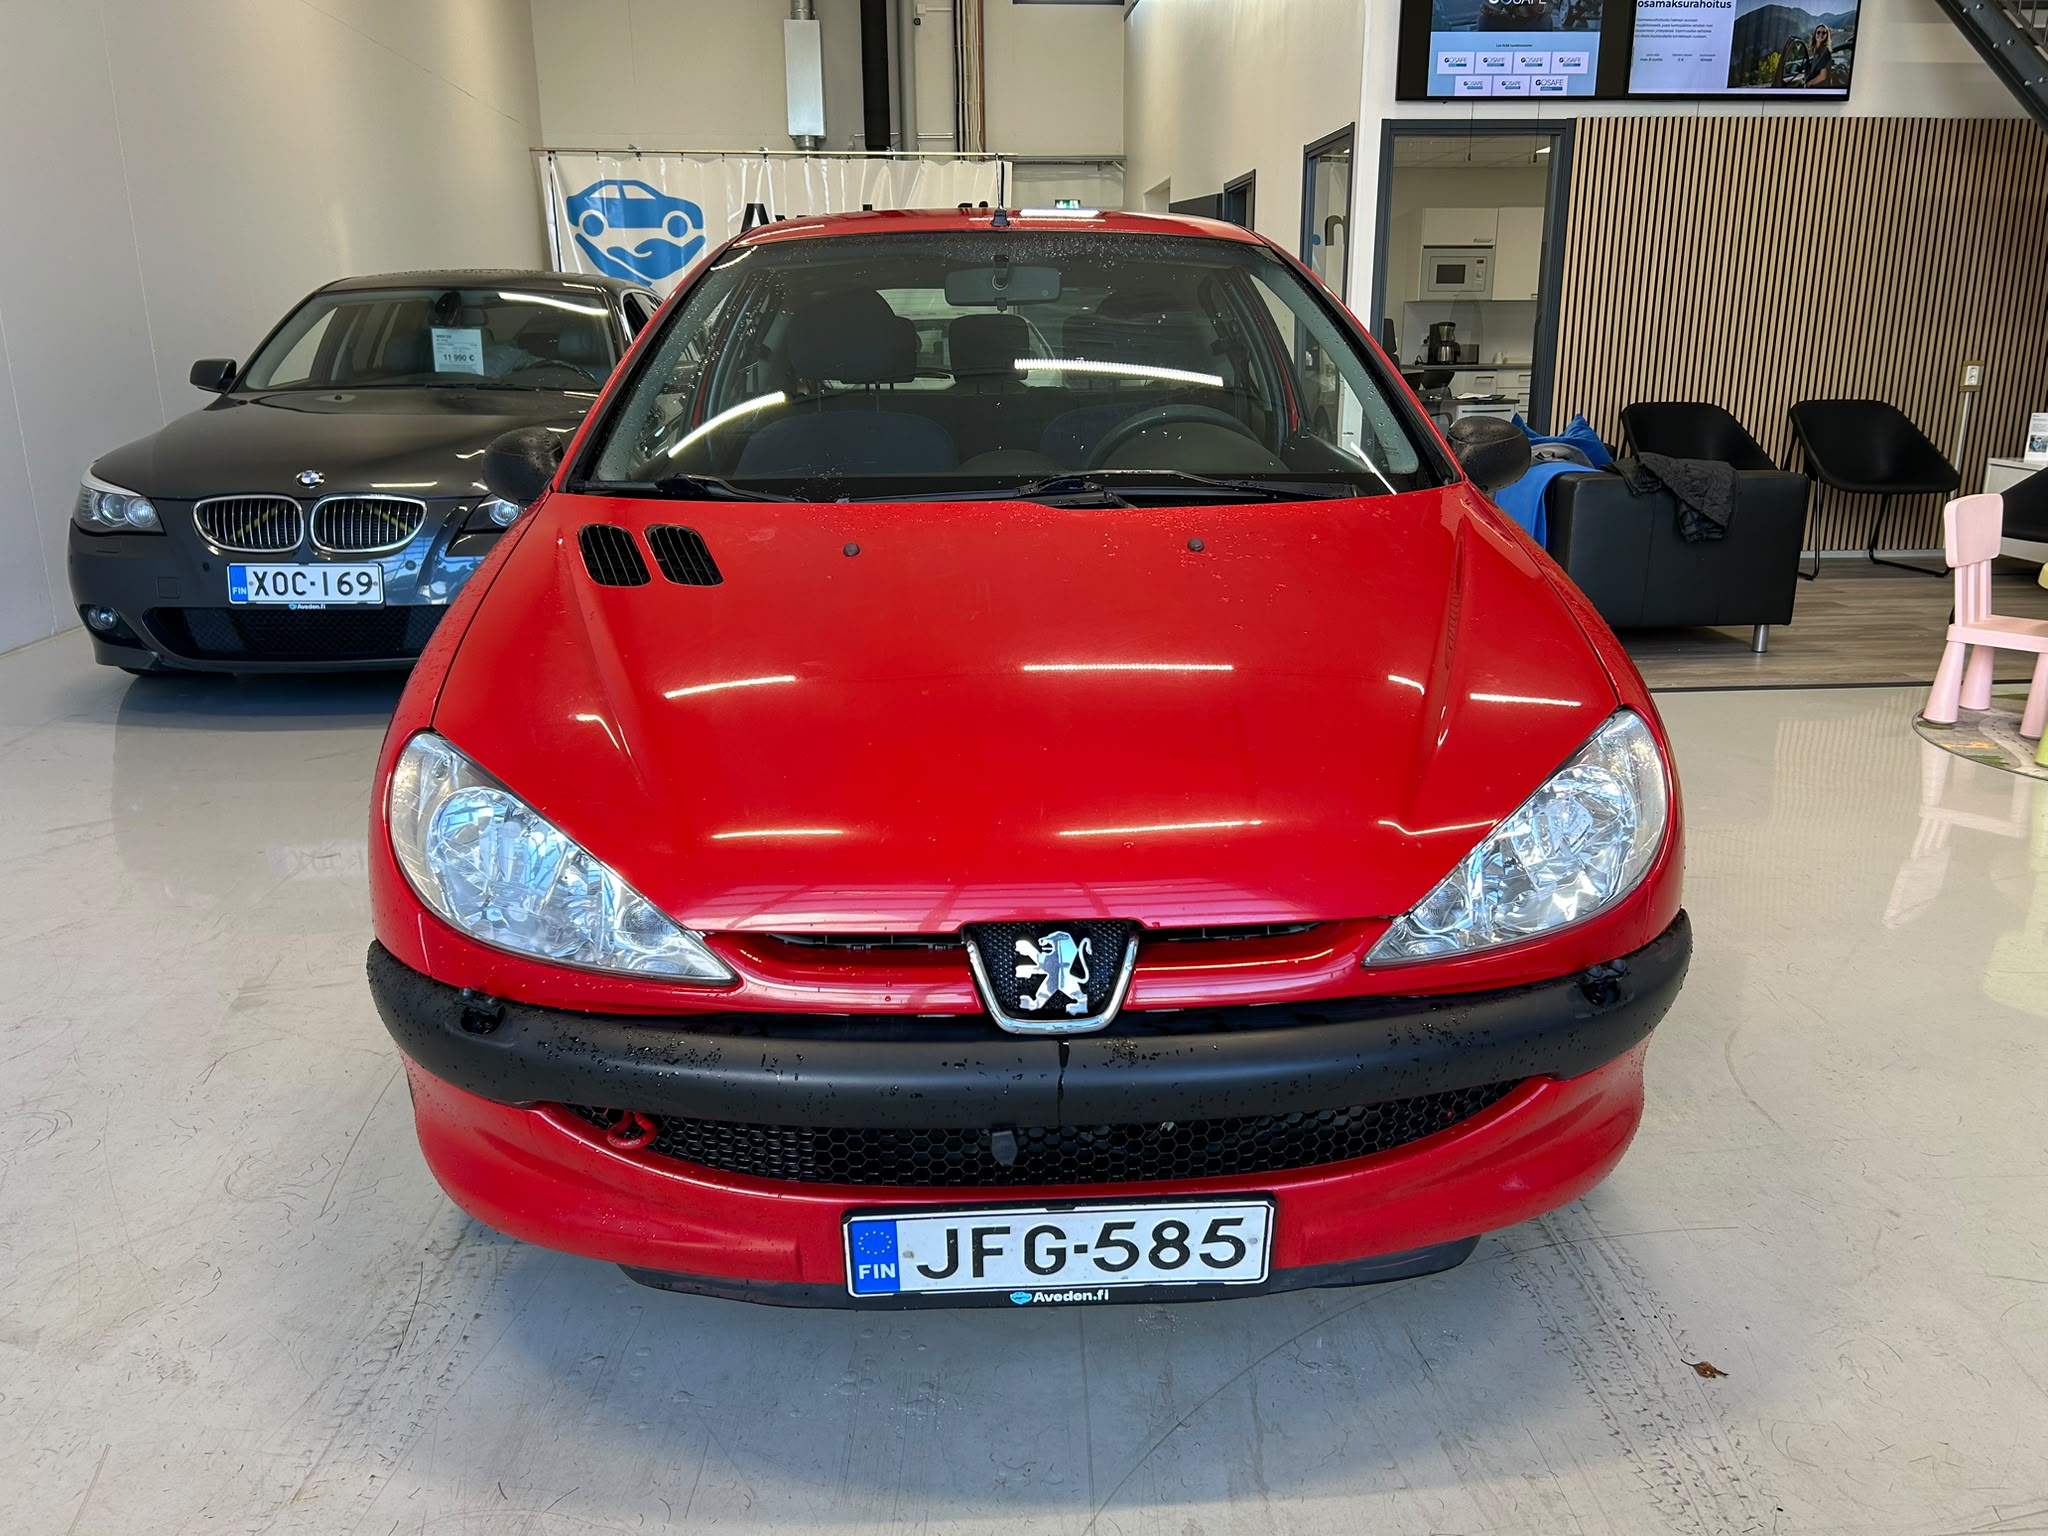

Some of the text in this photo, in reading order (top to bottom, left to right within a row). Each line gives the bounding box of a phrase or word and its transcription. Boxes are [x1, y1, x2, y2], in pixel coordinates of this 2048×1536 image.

[443, 353, 475, 362] 11 990 €
[232, 587, 247, 595] FIN
[252, 571, 373, 596] XOC-169
[916, 1217, 1247, 1280] JFG-585
[858, 1262, 896, 1280] FIN
